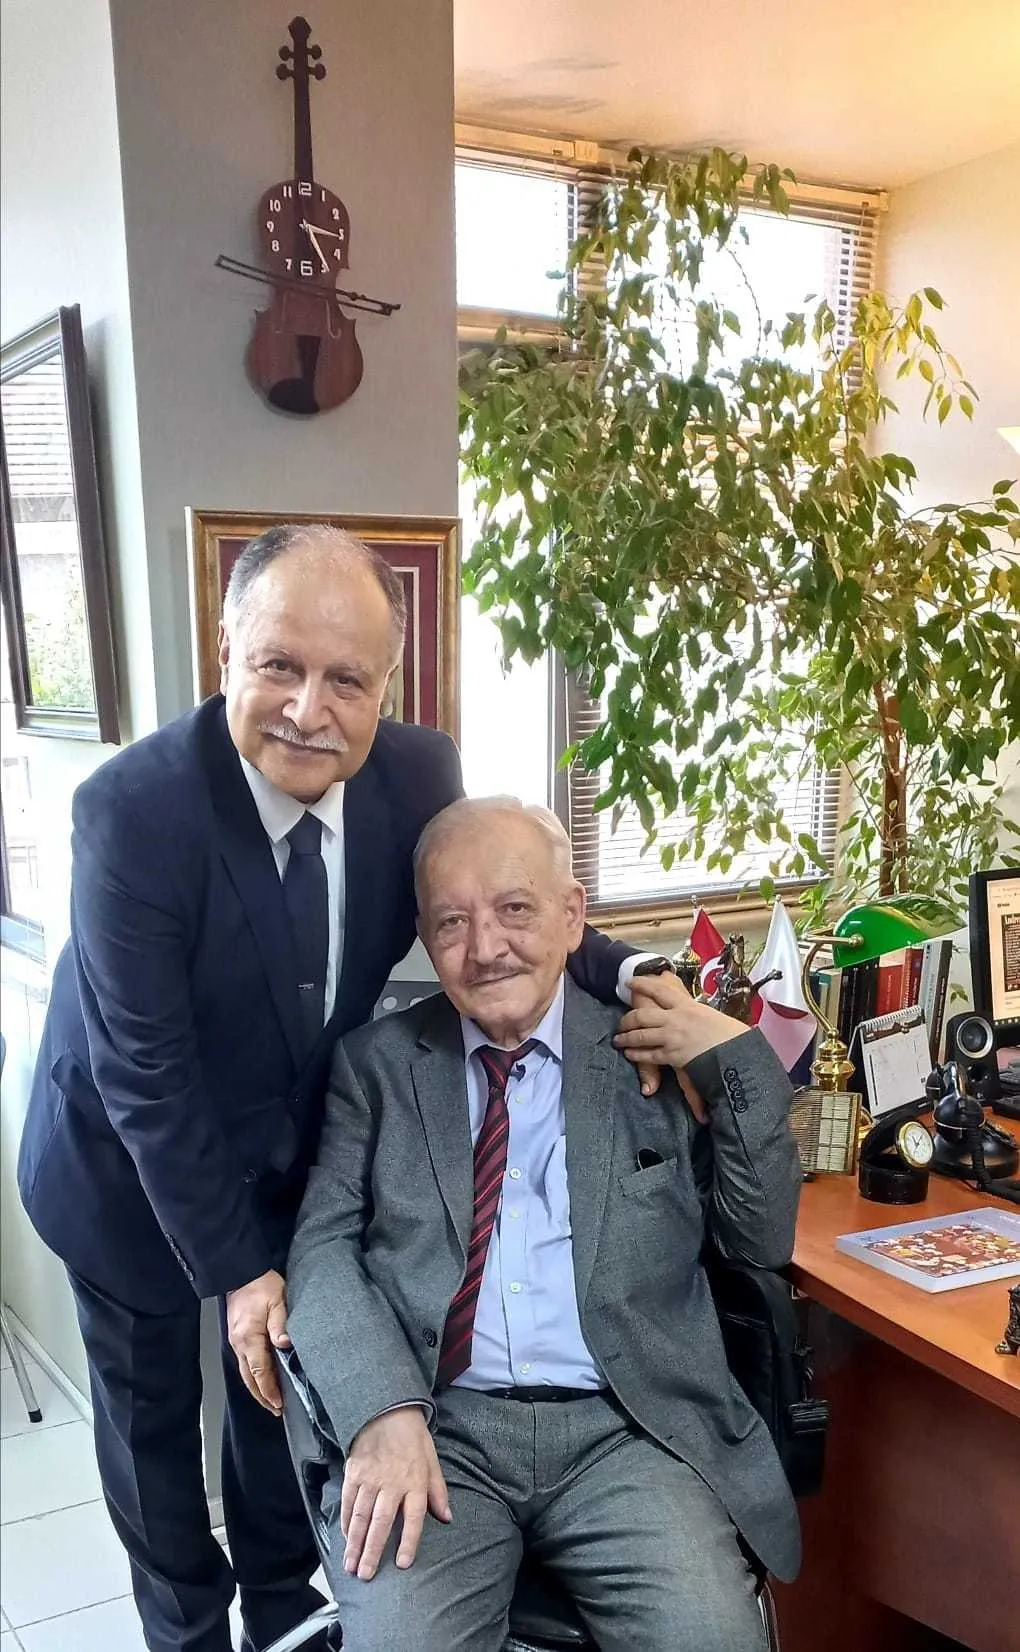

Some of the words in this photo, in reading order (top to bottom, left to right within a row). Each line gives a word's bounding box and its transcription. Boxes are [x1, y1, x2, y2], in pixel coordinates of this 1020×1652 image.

[283, 185, 292, 198] 11
[298, 181, 312, 196] 12
[321, 190, 326, 202] 1
[269, 199, 281, 212] 10
[332, 208, 340, 220] 2
[266, 221, 274, 232] 9
[271, 240, 280, 252] 8
[333, 248, 341, 260] 4
[285, 258, 292, 271] 7
[300, 260, 313, 276] 6
